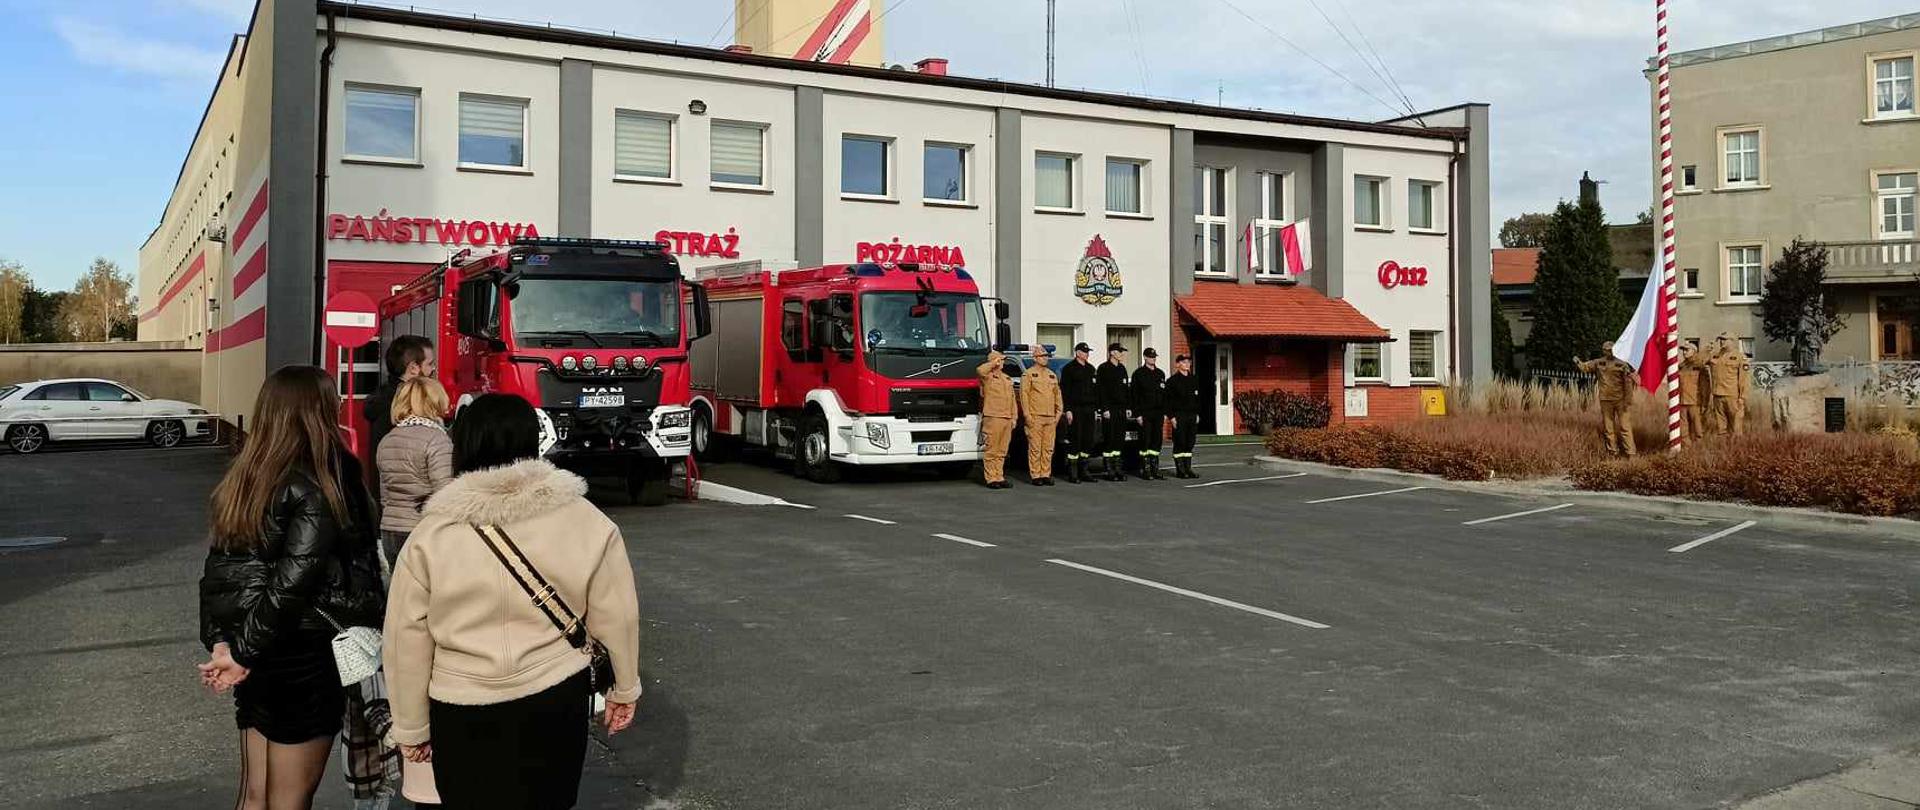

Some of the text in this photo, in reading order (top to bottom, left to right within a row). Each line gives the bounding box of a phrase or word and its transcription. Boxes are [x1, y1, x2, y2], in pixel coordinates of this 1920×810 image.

[655, 227, 740, 259] STRAŻ
[857, 237, 965, 267] POŻARNA
[1400, 266, 1428, 286] 112
[582, 387, 623, 395] MAN
